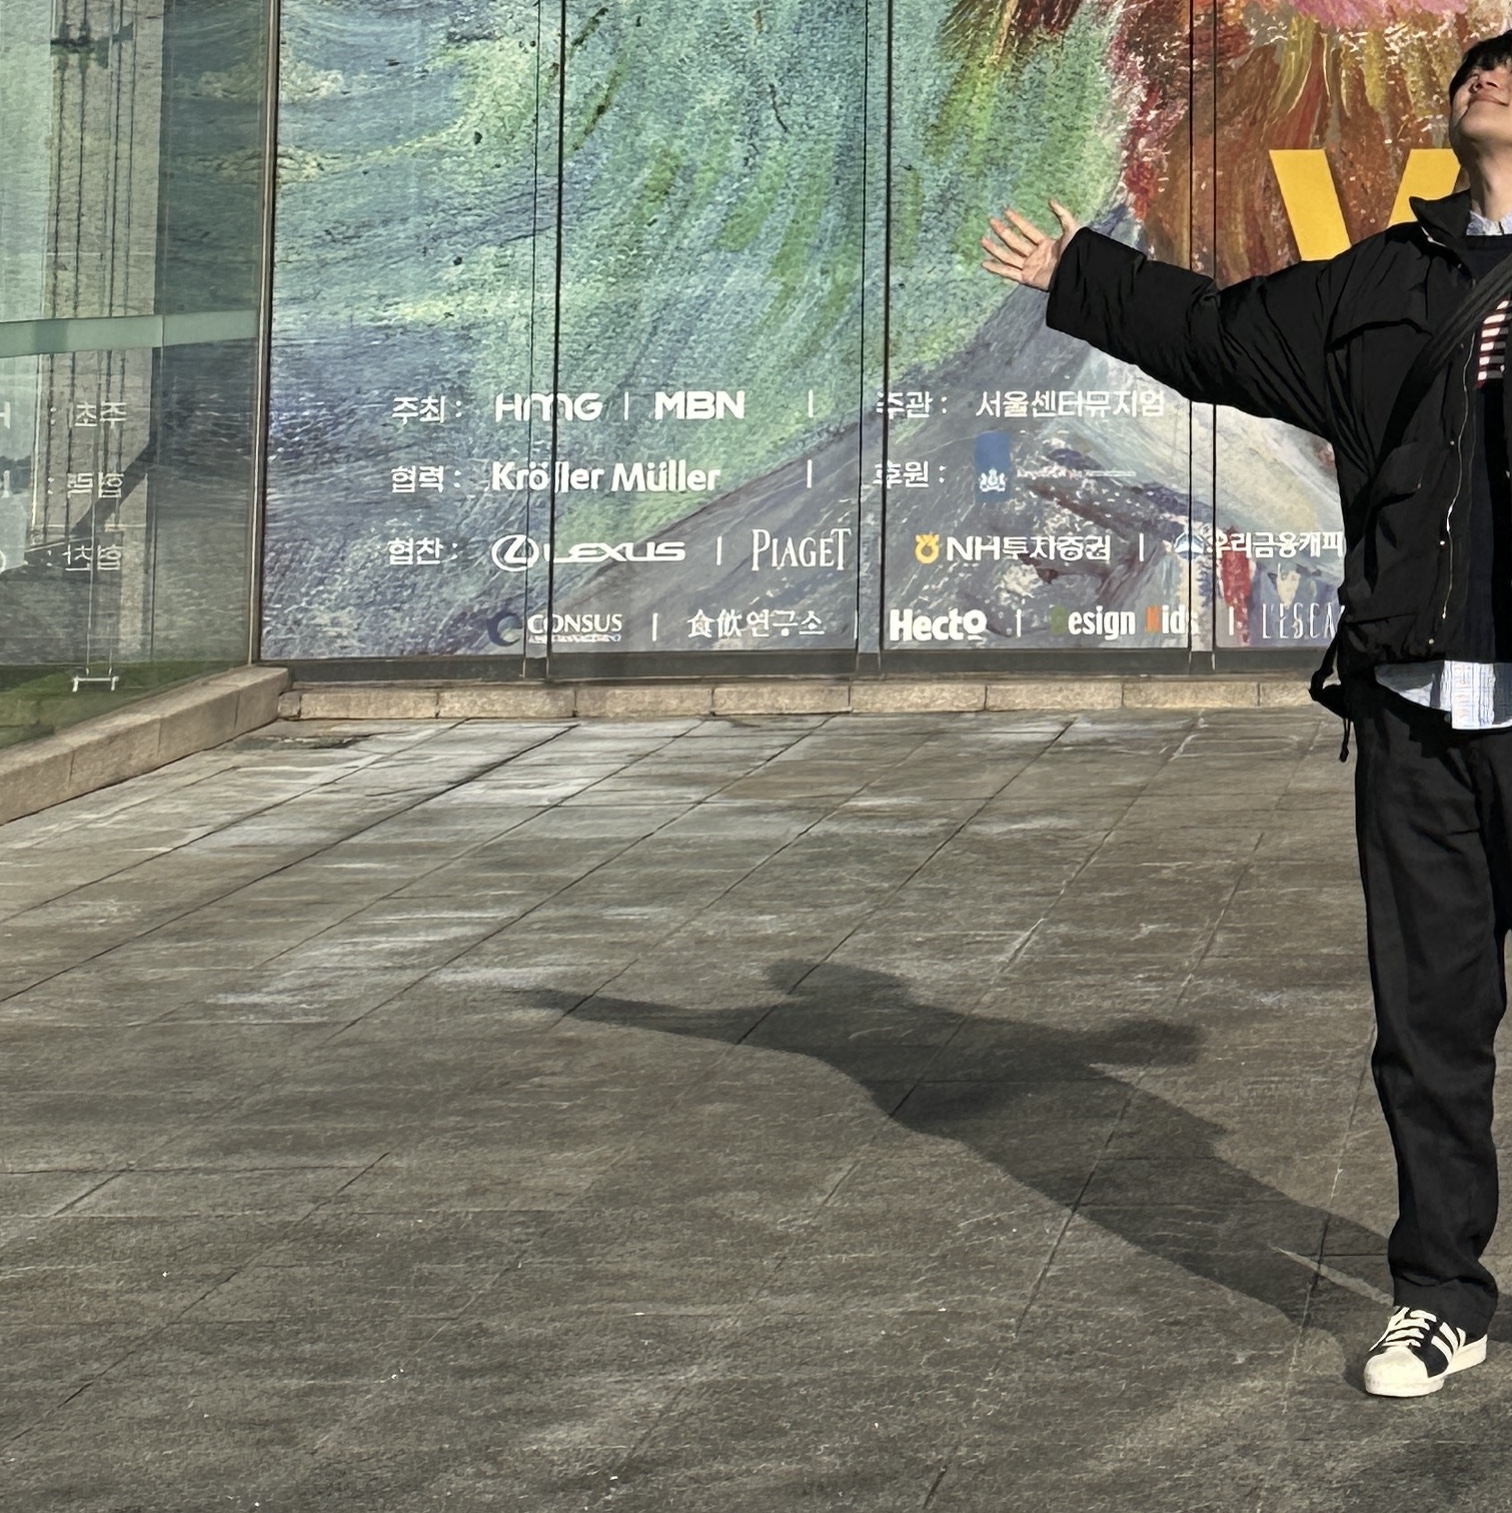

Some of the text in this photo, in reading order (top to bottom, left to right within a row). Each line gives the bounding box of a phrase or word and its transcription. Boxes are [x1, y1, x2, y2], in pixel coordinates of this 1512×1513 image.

[391, 395, 447, 426] 주최
[654, 390, 746, 421] MBN
[875, 390, 933, 419] 주관
[975, 389, 1166, 419] 서울센터뮤지엄
[390, 465, 446, 494] 협력
[491, 460, 605, 494] Kröller
[611, 459, 721, 492] Müller
[872, 460, 930, 489] 후원
[386, 536, 445, 567] 협찬
[543, 541, 686, 564] LEXUS
[751, 526, 852, 572] PIAGET
[945, 534, 1112, 563] NH투자증권
[527, 612, 623, 635] CONSUS
[889, 607, 988, 641] Hecto
